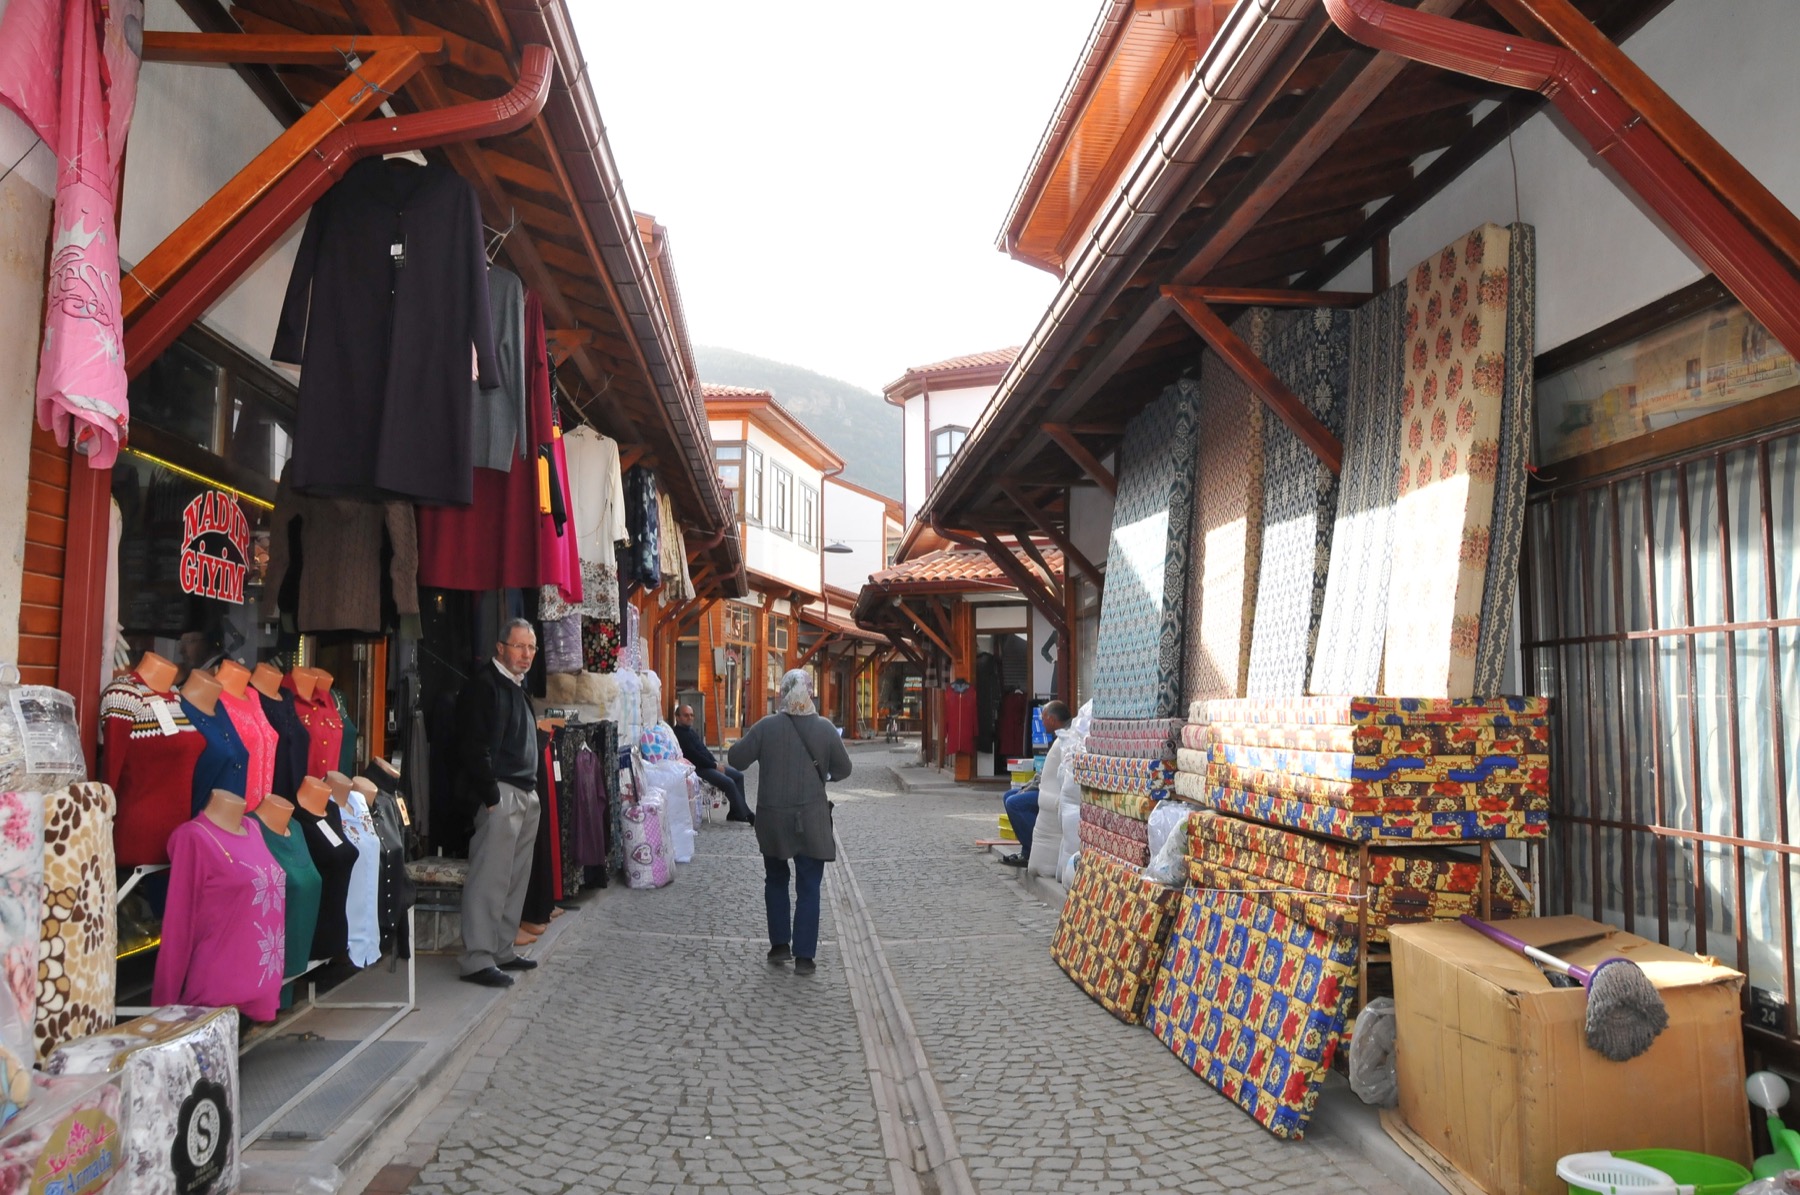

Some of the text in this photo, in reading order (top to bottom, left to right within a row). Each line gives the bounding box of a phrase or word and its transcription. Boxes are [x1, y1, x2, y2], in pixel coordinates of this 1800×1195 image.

[181, 490, 250, 573] NADİR
[180, 540, 245, 605] GİYİM
[1761, 1007, 1777, 1026] 24
[196, 1111, 212, 1156] S
[66, 1148, 113, 1194] Armada
